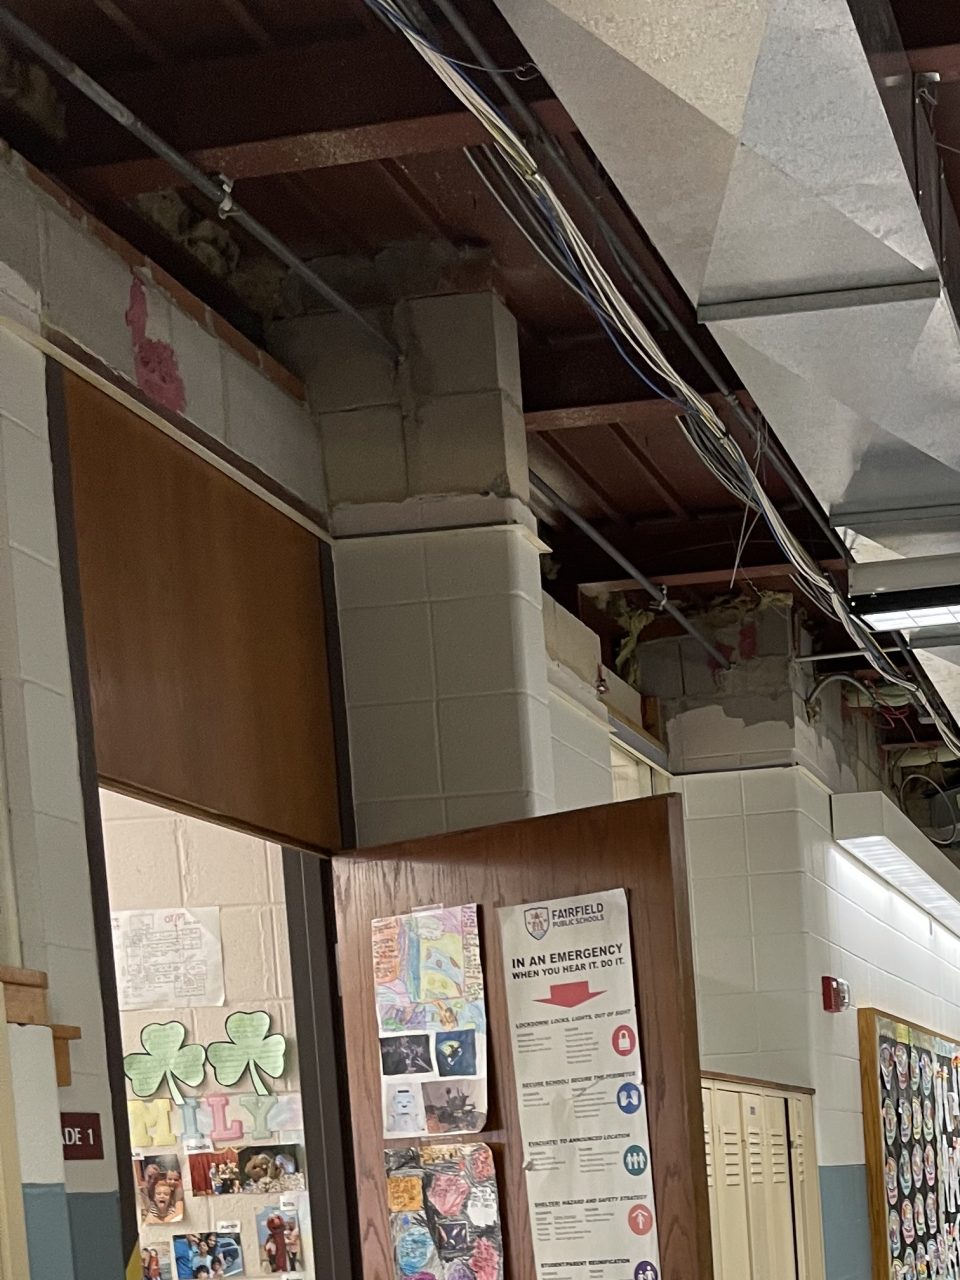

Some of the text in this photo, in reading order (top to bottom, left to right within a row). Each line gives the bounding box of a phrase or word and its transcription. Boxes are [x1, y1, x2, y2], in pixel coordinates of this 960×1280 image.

[552, 903, 604, 920] FAIRFIELD
[552, 914, 604, 928] PUBLIC SCHOOLS
[512, 943, 623, 969] IN AN EMERGENCY
[512, 969, 539, 980] WHEN
[542, 966, 560, 976] YOU
[562, 963, 586, 973] HEAR
[601, 959, 613, 968] DO
[615, 957, 625, 966] IT.
[62, 1128, 94, 1145] DE 1
